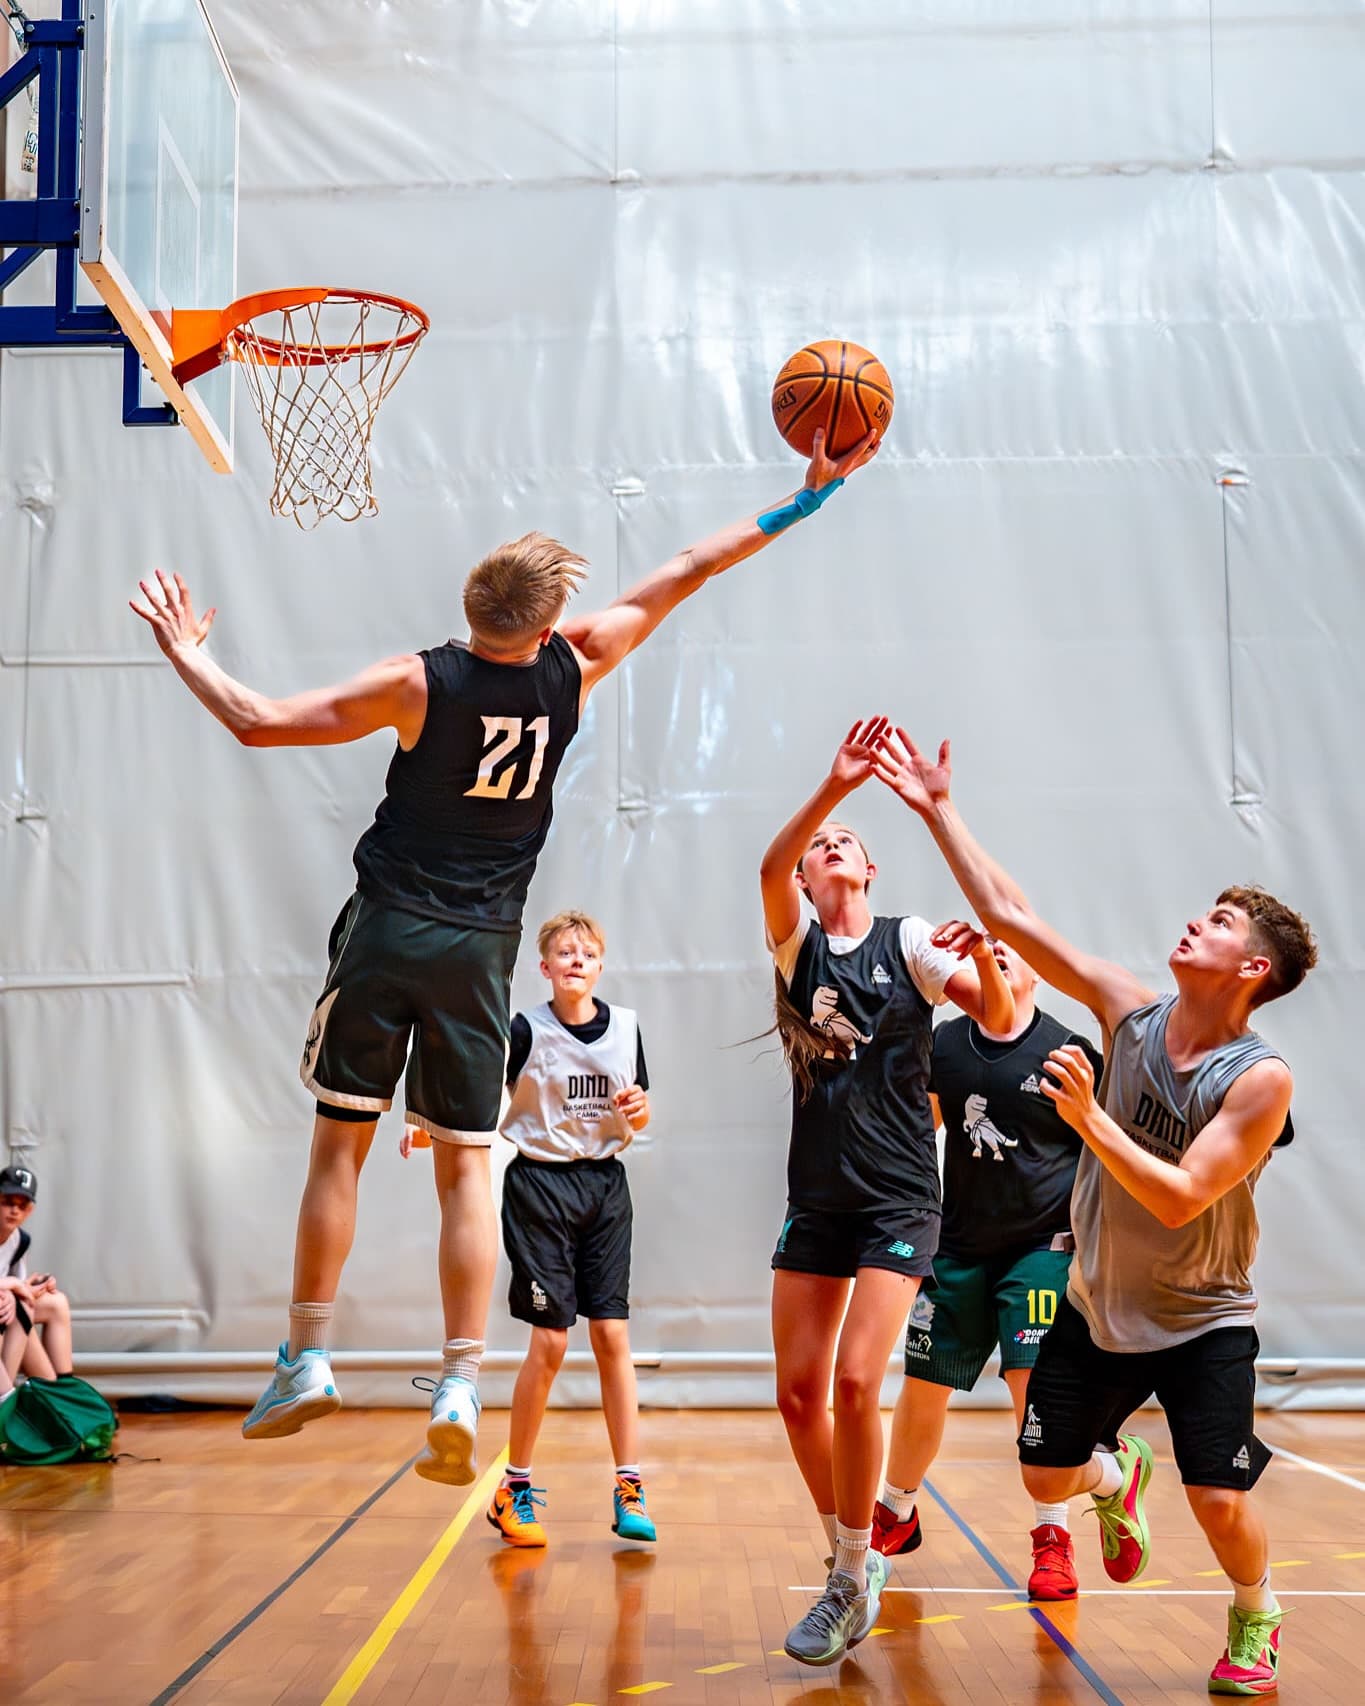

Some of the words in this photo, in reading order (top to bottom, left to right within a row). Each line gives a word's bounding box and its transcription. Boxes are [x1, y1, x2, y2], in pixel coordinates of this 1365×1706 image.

[463, 715, 550, 800] 21
[567, 1074, 609, 1099] DINO
[563, 1102, 612, 1112] BASKETBALL
[1132, 1091, 1186, 1151] DINO
[1027, 1289, 1057, 1325] 10
